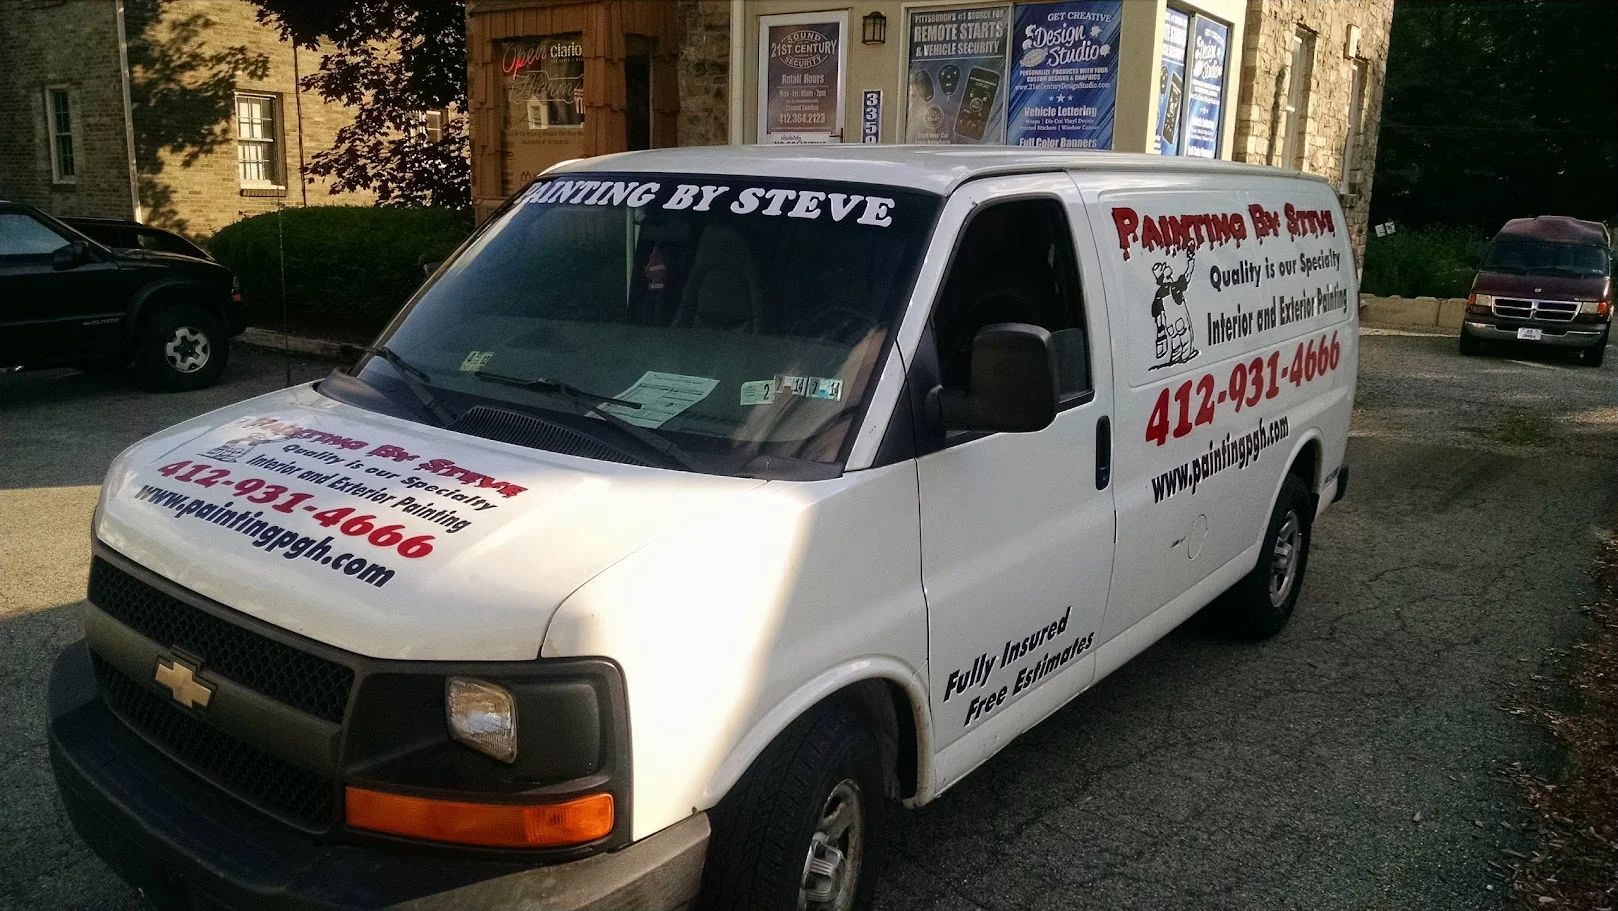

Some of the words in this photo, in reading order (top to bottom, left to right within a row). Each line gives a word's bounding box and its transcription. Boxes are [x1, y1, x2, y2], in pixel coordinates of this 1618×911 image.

[967, 11, 992, 20] SOURCE
[993, 9, 1004, 18] FOR
[1048, 12, 1066, 21] GET
[1067, 11, 1112, 23] CREATIVE
[788, 31, 821, 43] SOUND
[914, 23, 958, 42] REMOTE
[960, 21, 1004, 40] STARTS
[1033, 22, 1087, 48] Design
[550, 42, 583, 58] clario
[771, 43, 791, 58] 21ST
[794, 39, 838, 55] CENTURY
[784, 54, 822, 68] SECURITY
[916, 47, 922, 57] &
[924, 43, 956, 56] VEHICLE
[958, 41, 1000, 55] SECURITY
[1047, 40, 1099, 67] Studio
[502, 44, 547, 80] Open
[782, 74, 801, 85] Retail
[804, 73, 825, 84] Hours
[778, 112, 826, 124] 412.364.2123
[1024, 106, 1057, 117] Vehicle
[1058, 105, 1097, 118] Lettering
[1019, 138, 1035, 148] Full
[1036, 137, 1059, 148] Color
[1061, 137, 1097, 148] Banners
[514, 180, 661, 207] PAINTING
[662, 184, 729, 211] BY
[730, 187, 895, 228] STEVE
[1209, 258, 1262, 293] Quality
[1265, 257, 1276, 280] is
[1279, 259, 1298, 277] our
[1299, 249, 1341, 278] Specialty
[1207, 303, 1254, 347] Interior
[1256, 296, 1277, 331] and
[1279, 290, 1316, 326] Exterior
[1317, 283, 1348, 316] Painting
[1145, 330, 1341, 447] 412-931-4666
[1151, 416, 1289, 504] www.paintingpgh.com
[282, 444, 346, 465] Quality
[344, 460, 364, 470] is
[365, 467, 401, 480] our
[400, 476, 498, 511] Specialty
[246, 454, 304, 475] Interior
[301, 464, 335, 487] and
[328, 474, 397, 505] Exterior
[390, 496, 472, 534] Painting
[157, 460, 436, 560] 412-931-4666
[134, 484, 397, 589] www.paintingpgh.com
[943, 652, 998, 703] Fully
[999, 605, 1072, 669] Insured
[964, 685, 1008, 727] Free
[1012, 632, 1095, 696] Estimates
